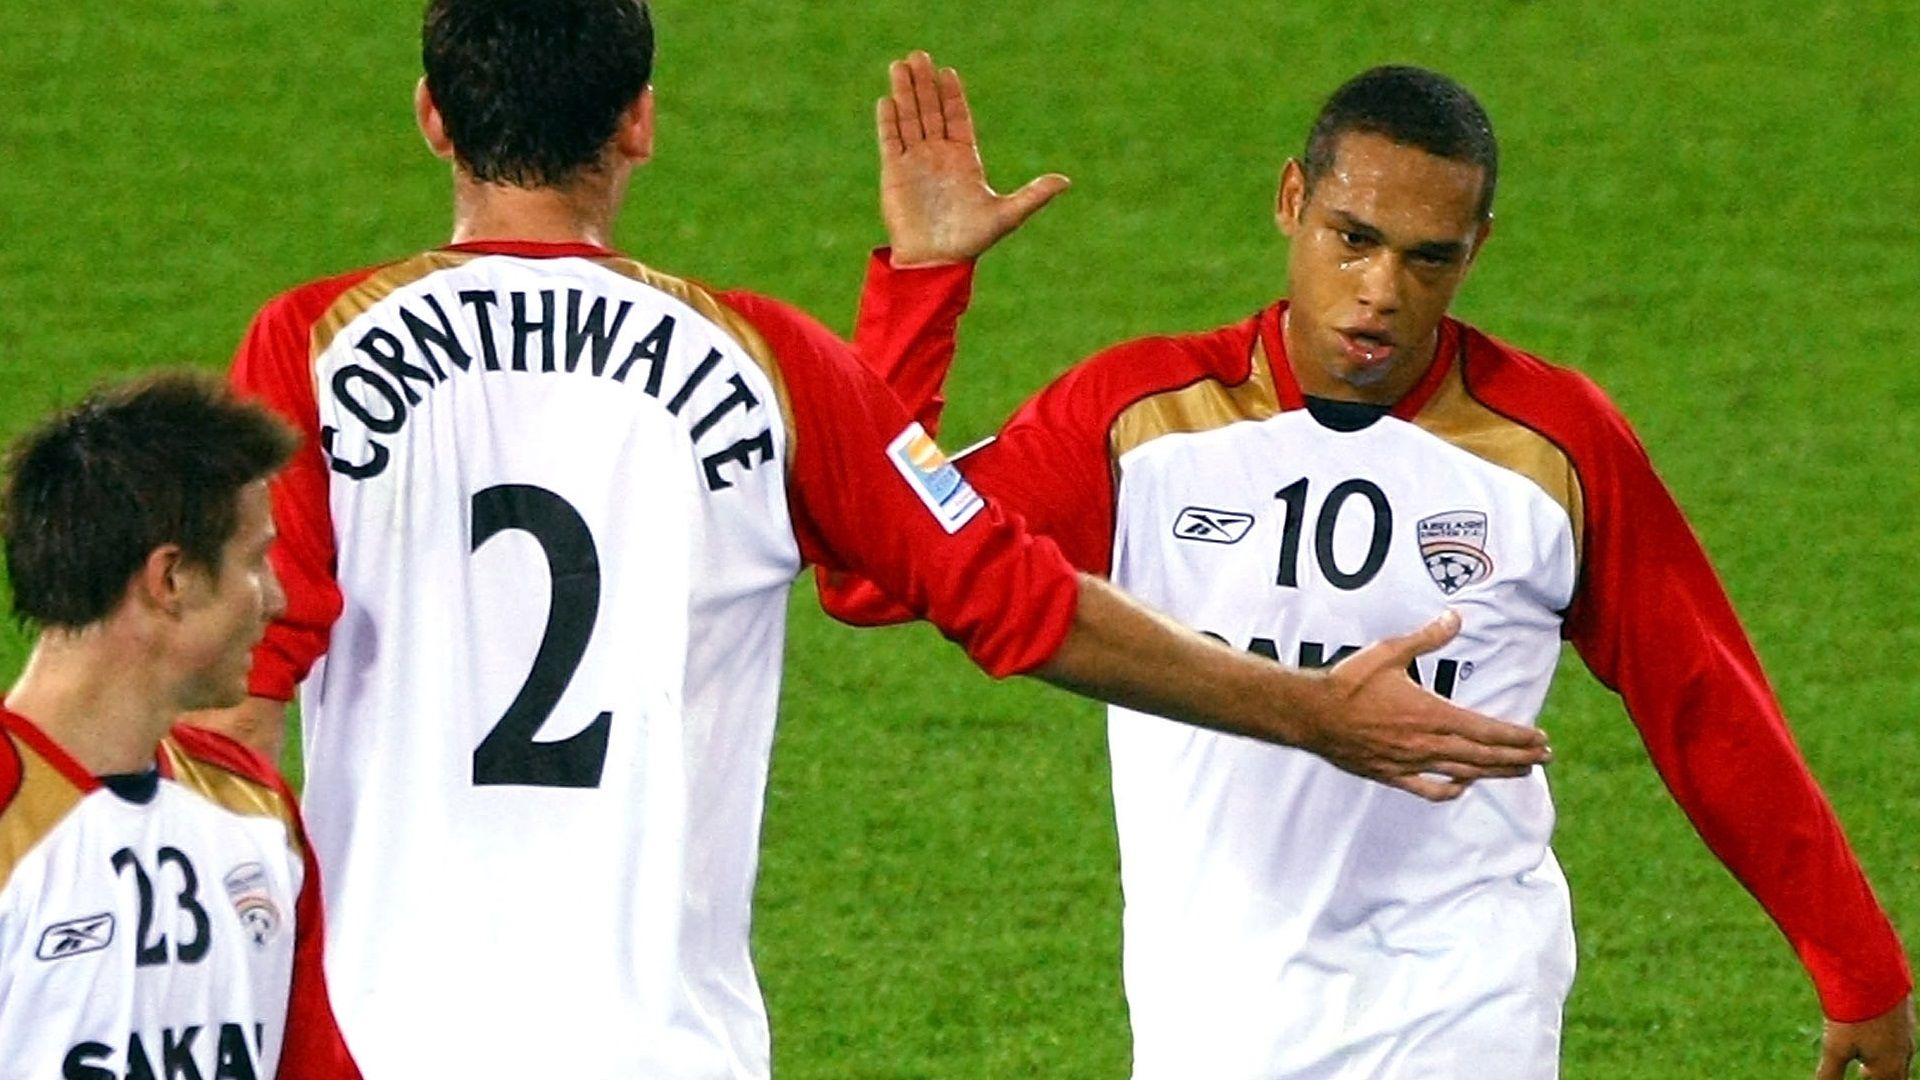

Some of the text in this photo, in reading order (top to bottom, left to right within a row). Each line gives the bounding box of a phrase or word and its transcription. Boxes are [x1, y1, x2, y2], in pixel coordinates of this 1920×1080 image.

[321, 288, 775, 492] CORNTHWAITE
[1274, 476, 1393, 590] 10
[470, 483, 613, 788] 2
[111, 846, 211, 968] 23
